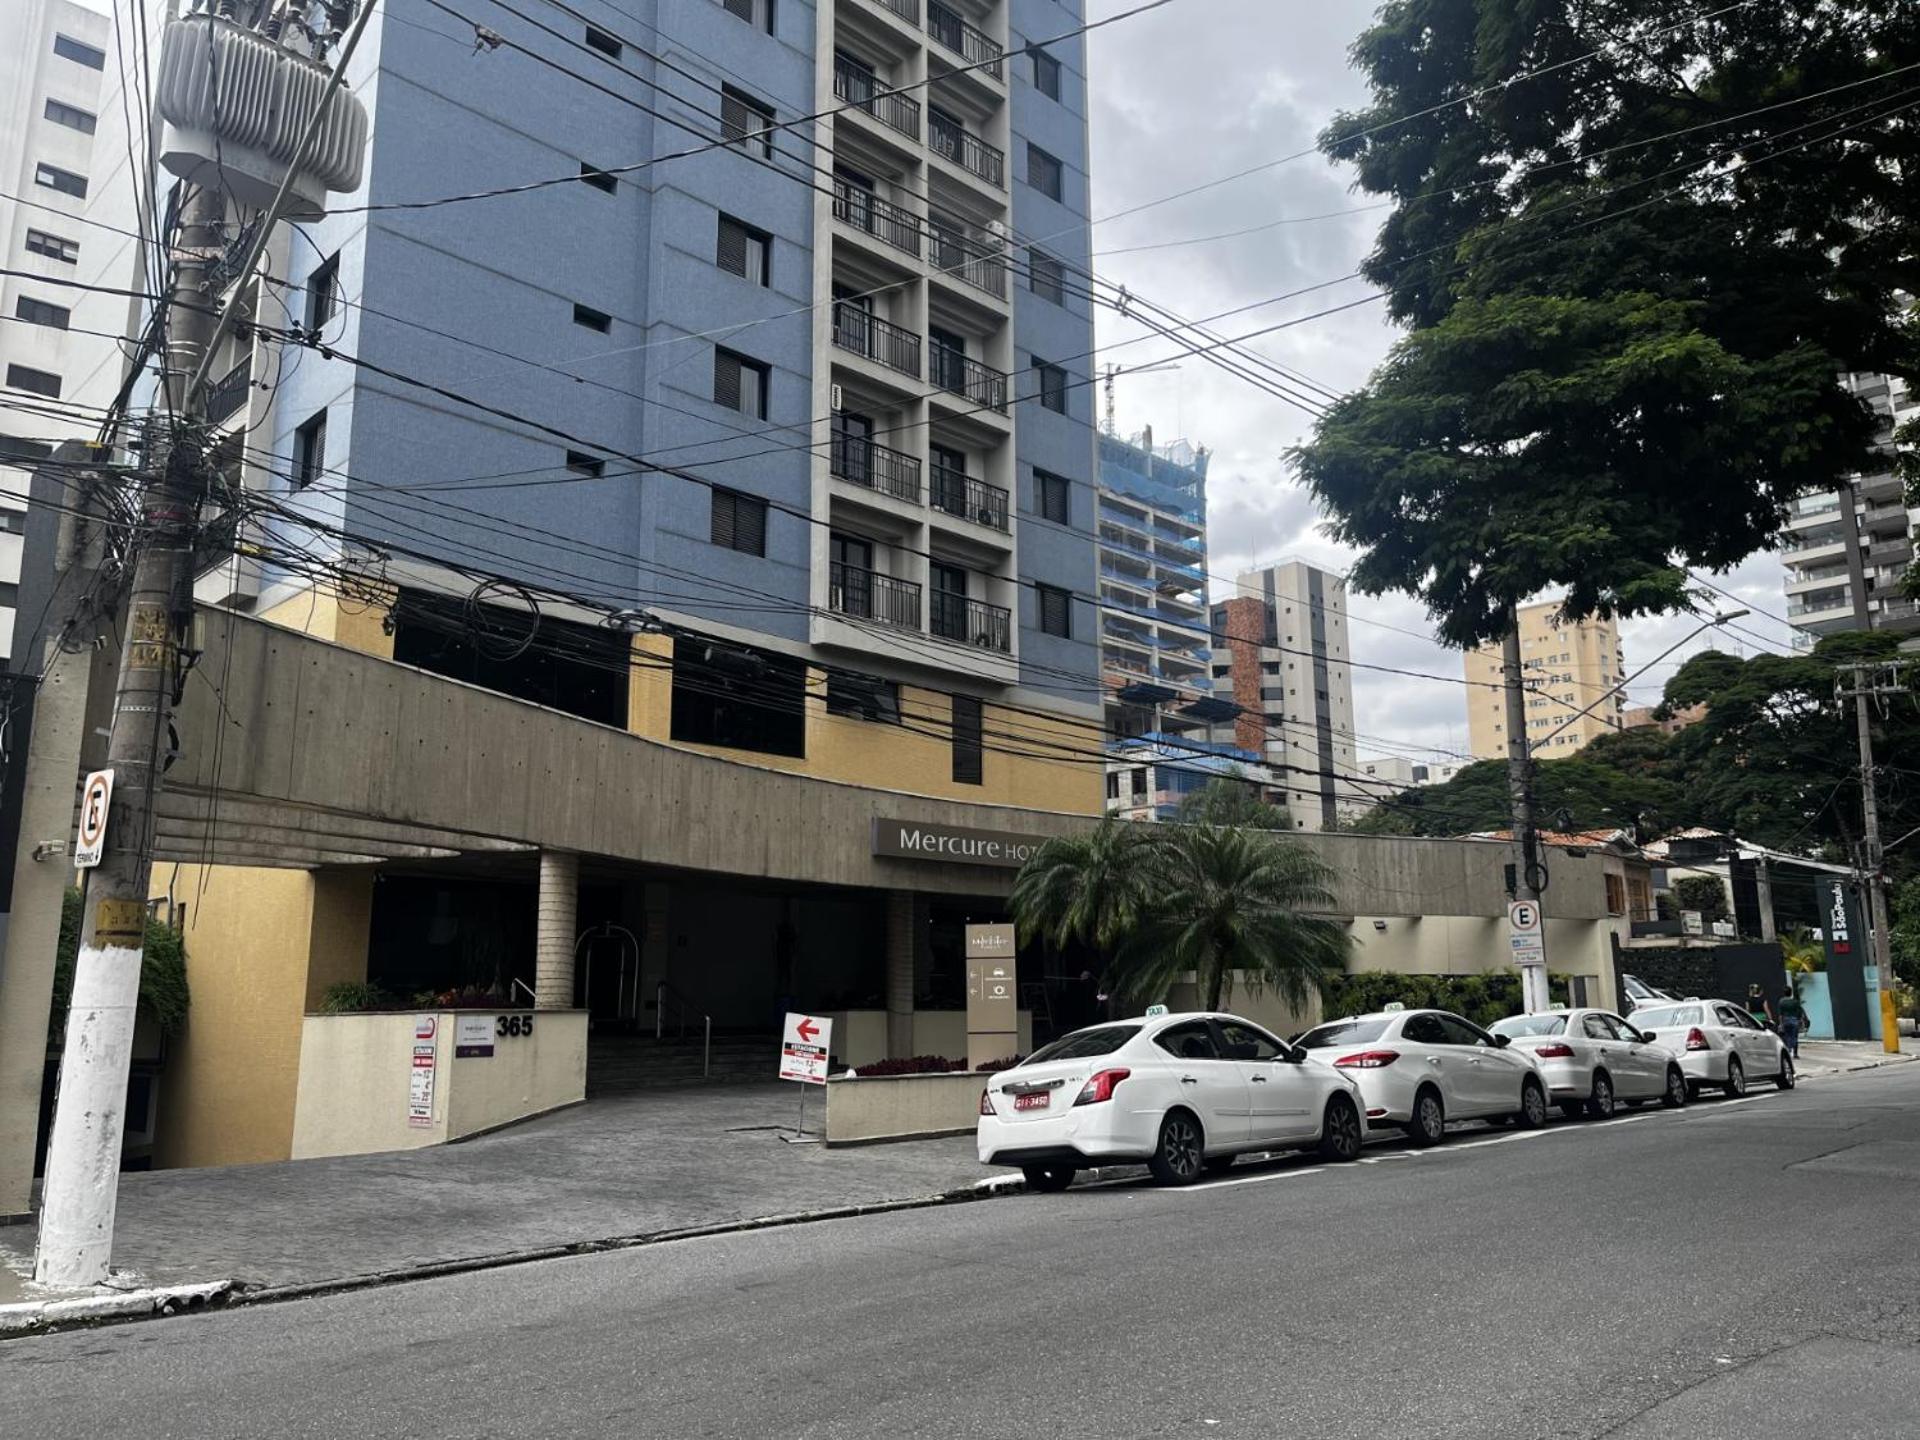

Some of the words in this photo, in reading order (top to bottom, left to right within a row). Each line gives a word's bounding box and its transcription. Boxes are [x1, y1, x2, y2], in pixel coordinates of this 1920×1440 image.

[900, 828, 1001, 858] Mercure
[1519, 908, 1530, 925] E
[1148, 1006, 1163, 1016] TAXI
[496, 1015, 533, 1037] 365
